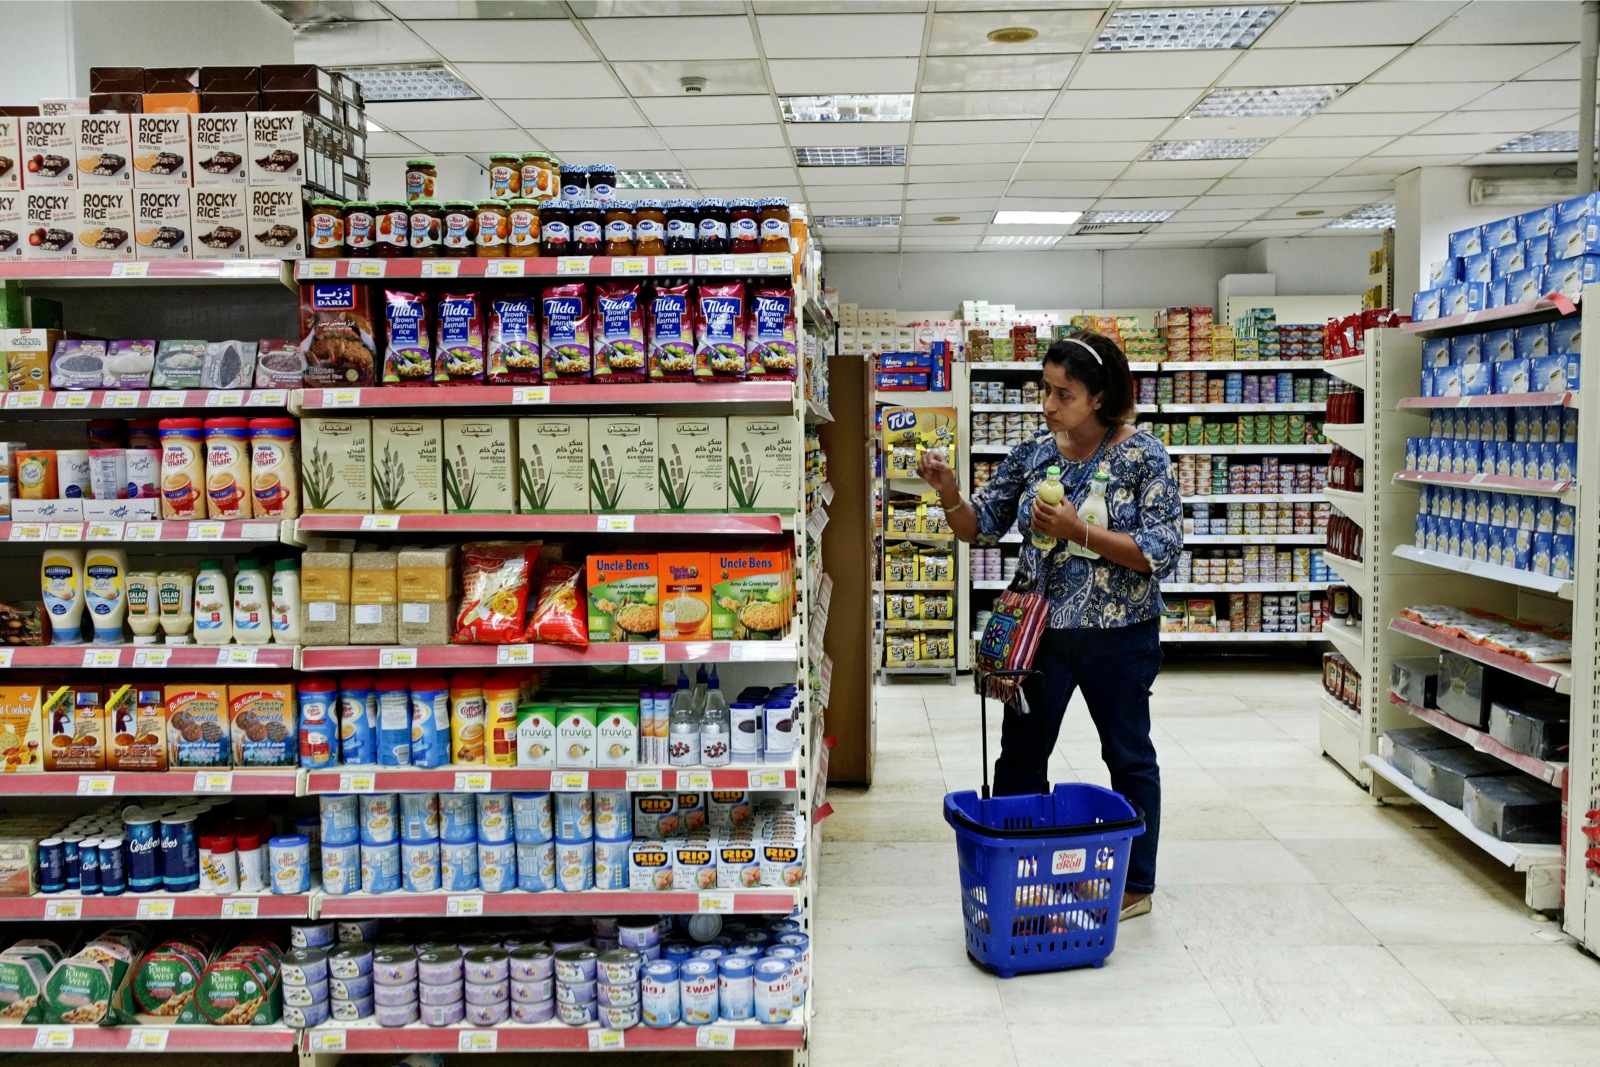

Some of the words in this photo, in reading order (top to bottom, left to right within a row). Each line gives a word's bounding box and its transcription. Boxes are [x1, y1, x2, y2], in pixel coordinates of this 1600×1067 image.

[81, 119, 121, 134] ROCKY
[139, 118, 179, 133] ROCKY
[198, 118, 238, 133] ROCKY
[253, 116, 294, 130] ROCKY
[26, 121, 66, 136] ROCKY
[81, 134, 104, 145] RICE
[139, 133, 163, 144] RICE
[198, 132, 220, 144] RICE
[255, 130, 278, 141] RICE
[26, 136, 49, 147] RICE
[27, 195, 69, 210] ROCKY
[83, 194, 123, 208] ROCKY
[140, 193, 180, 207] ROCKY
[197, 193, 237, 207] ROCKY
[253, 191, 293, 205] ROCKY
[28, 209, 51, 220] RICE
[83, 208, 107, 219] RICE
[140, 207, 163, 219] RICE
[197, 207, 220, 218] RICE
[253, 205, 276, 217] RICE
[391, 302, 419, 317] Tilda
[441, 301, 470, 316] Tilda
[499, 300, 528, 312] Tilda
[548, 301, 577, 314] Tilda
[604, 300, 632, 311] Tilda
[655, 299, 682, 311] Tilda
[706, 301, 735, 313] Tilda
[888, 411, 915, 429] TUC
[491, 439, 505, 447] سكر
[568, 439, 583, 447] سكر
[777, 437, 792, 445] سكر
[479, 446, 490, 454] خام
[492, 447, 506, 455] بني
[555, 446, 567, 454] خام
[569, 446, 583, 455] بني
[640, 446, 654, 454] بني
[694, 445, 707, 453] خام
[708, 445, 722, 454] بني
[764, 444, 777, 452] خام
[778, 445, 792, 453] بني
[167, 458, 188, 466] mate
[212, 458, 232, 466] mate
[38, 504, 55, 514] Crystal
[45, 508, 58, 517] Light
[109, 505, 127, 515] Crystal
[115, 509, 130, 519] Light
[596, 560, 624, 571] Uncle
[625, 559, 650, 570] Ben's
[720, 557, 746, 569] Uncle
[748, 557, 773, 568] Ben's
[546, 569, 574, 578] ASET
[669, 566, 688, 574] Uncle
[6, 706, 33, 715] Cookies
[169, 700, 178, 712] Be
[190, 702, 219, 710] Healthy
[233, 700, 242, 712] Be
[254, 702, 284, 710] Healthy
[460, 704, 482, 714] Coffee
[182, 708, 218, 722] Cookies
[247, 708, 283, 722] Cookies
[51, 750, 100, 758] DIABETIC
[114, 748, 162, 757] DIABETIC
[713, 791, 743, 799] RIO
[641, 799, 672, 809] RIO
[635, 853, 666, 862] RIO
[679, 851, 710, 860] RIO
[722, 849, 753, 859] RIO
[765, 848, 796, 857] RIO
[1058, 852, 1077, 860] Shop
[65, 969, 88, 979] JOHN
[148, 966, 170, 977] JOHN
[69, 977, 90, 986] WEST
[211, 975, 234, 985] JOHN
[685, 984, 716, 994] ZWAN
